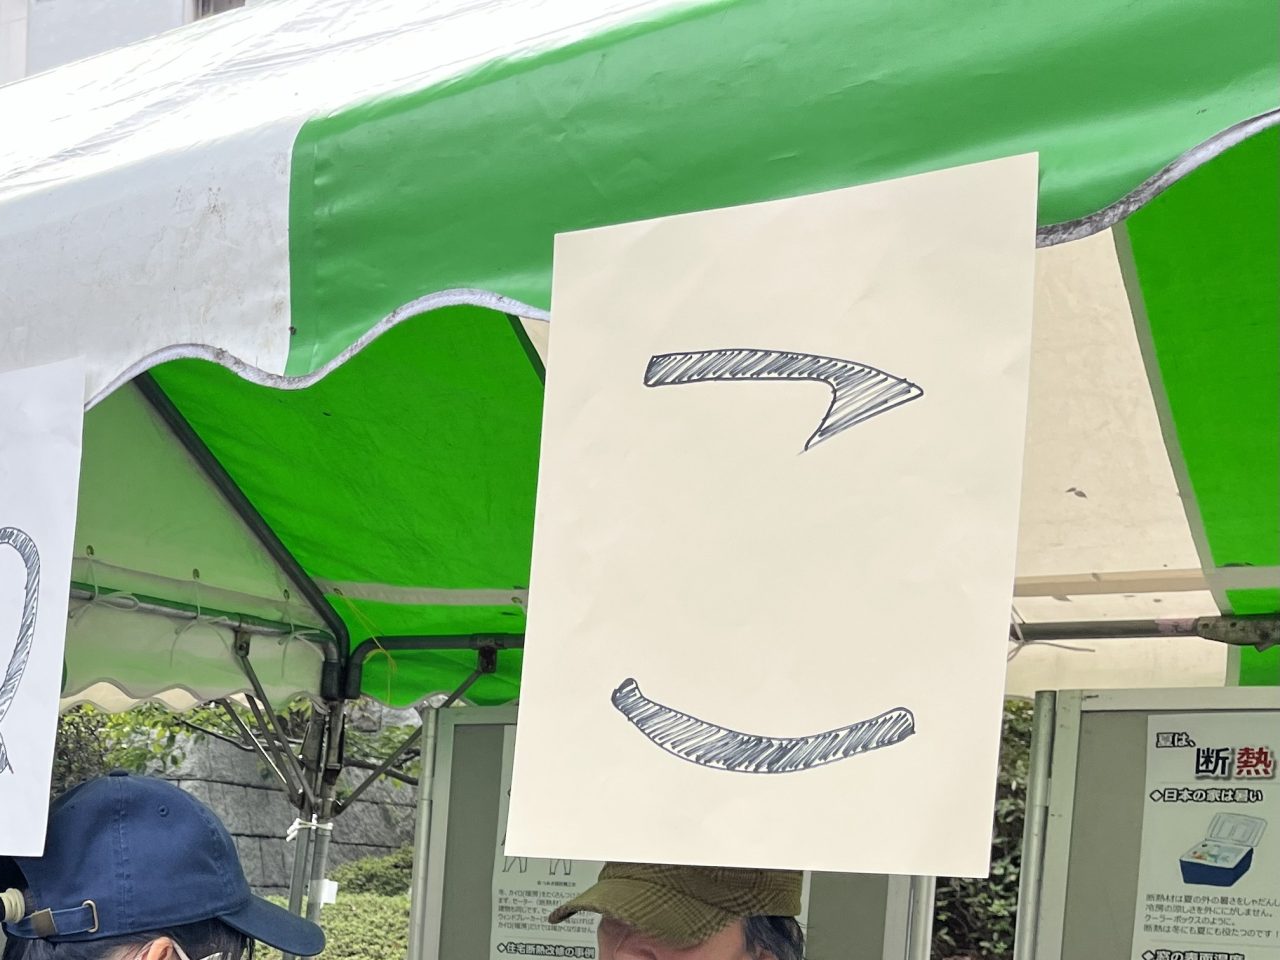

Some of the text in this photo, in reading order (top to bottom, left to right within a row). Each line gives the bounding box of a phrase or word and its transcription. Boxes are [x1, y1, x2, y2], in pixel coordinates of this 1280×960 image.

[610, 348, 925, 774] こ
[1156, 732, 1196, 748] 夏は、
[1194, 746, 1273, 776] 断熱
